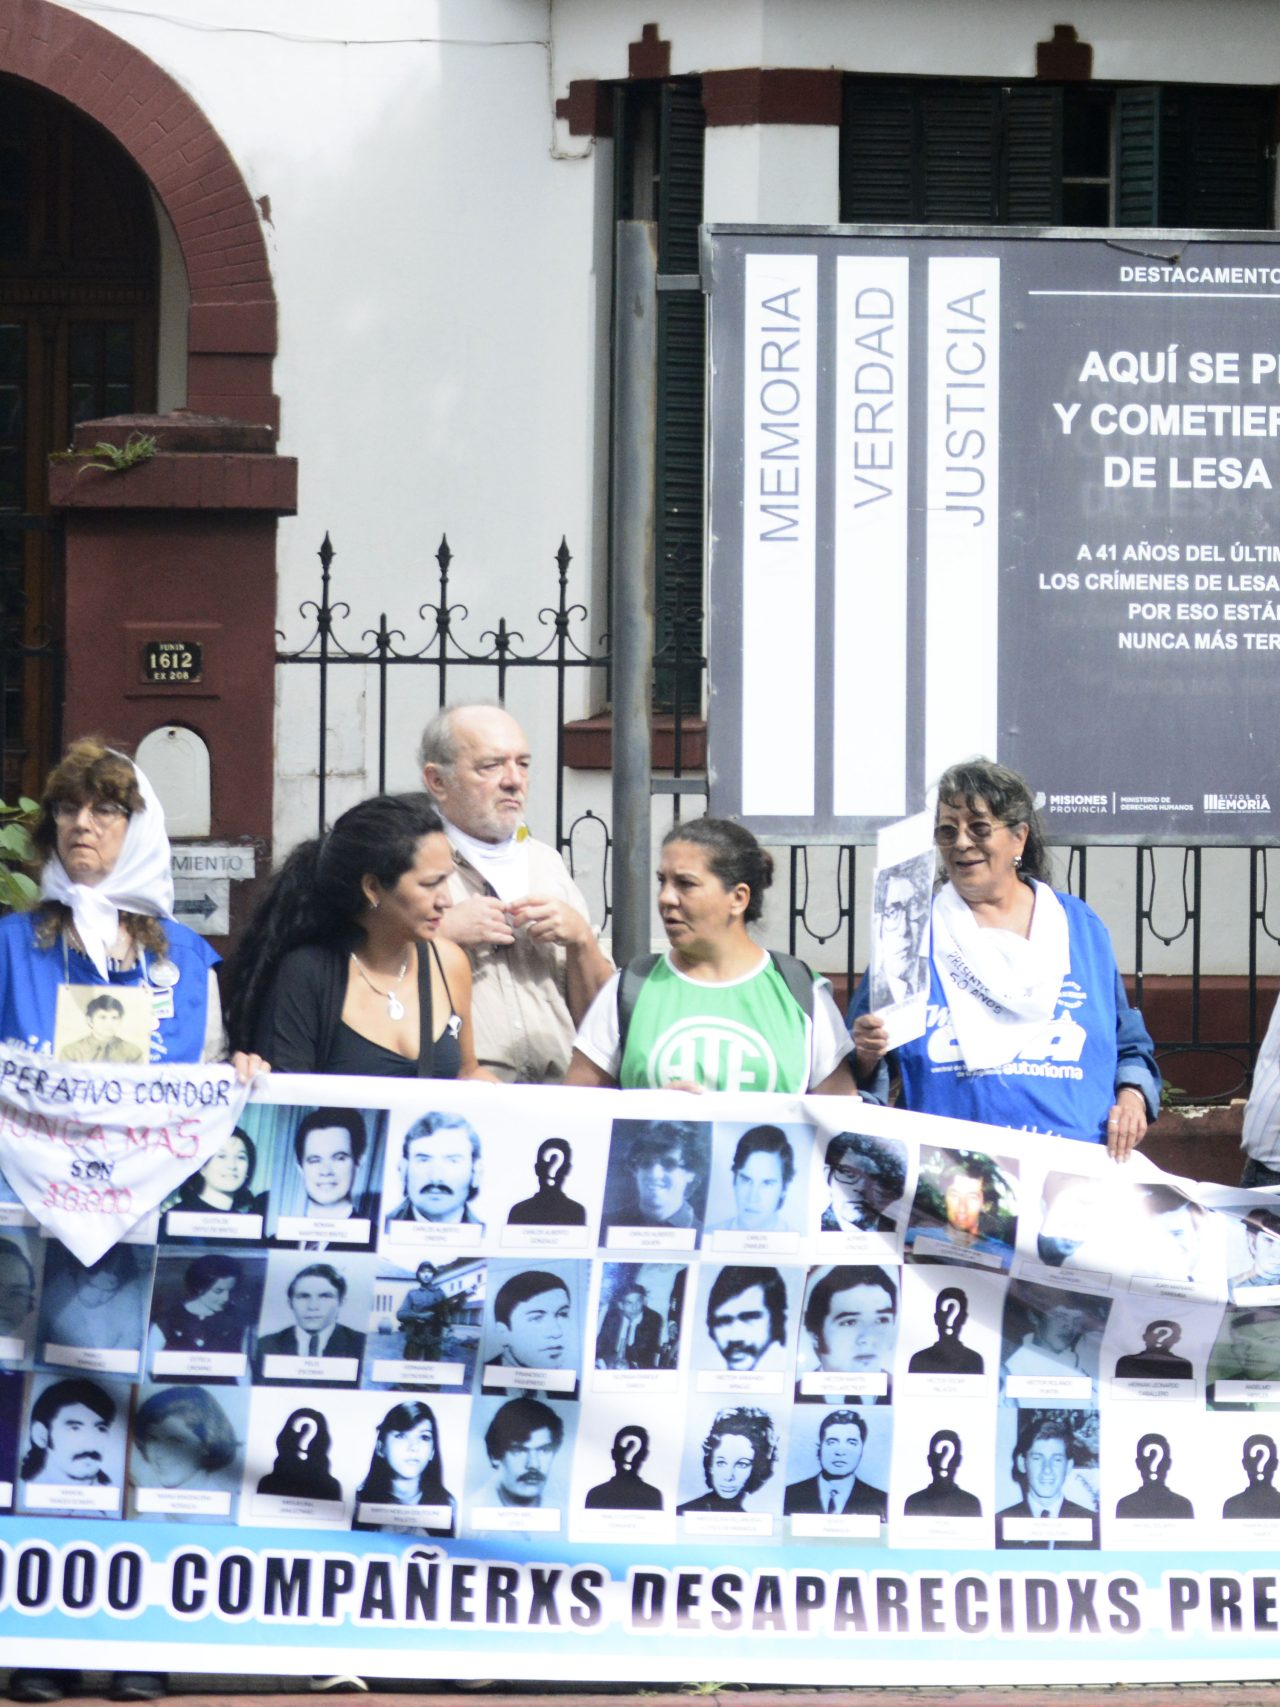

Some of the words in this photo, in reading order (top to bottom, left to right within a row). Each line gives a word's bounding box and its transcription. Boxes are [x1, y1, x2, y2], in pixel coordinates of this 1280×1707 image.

[1079, 347, 1176, 386] AQUÍ
[1189, 352, 1239, 385] SE
[855, 287, 893, 507] VERDAD
[946, 290, 986, 525] JUSTICIA
[761, 290, 799, 540] MEMORIA
[1053, 403, 1081, 435] Y
[1104, 456, 1157, 489] DE
[1169, 457, 1273, 491] LESA
[1077, 544, 1092, 561] A
[1096, 544, 1117, 561] 41
[1122, 541, 1180, 562] AÑOS
[1186, 545, 1225, 562] DEL
[1039, 573, 1080, 591] LOS
[1085, 570, 1189, 592] CRÍMENES
[1194, 574, 1222, 591] DE
[1228, 575, 1280, 592] LESA
[1128, 603, 1172, 621] POR
[1177, 603, 1218, 621] ESO
[1119, 632, 1190, 650] NUNCA
[1194, 628, 1238, 650] MÁS
[150, 652, 193, 669] 1612
[1050, 795, 1108, 805] MISIONES
[1050, 805, 1107, 814] PROVINCIA
[0, 1060, 122, 1104] PERATIVO
[71, 1159, 114, 1181] SON
[171, 1551, 604, 1629] COMPAÑERXS
[631, 1571, 1143, 1634] DESAPARECIDXS
